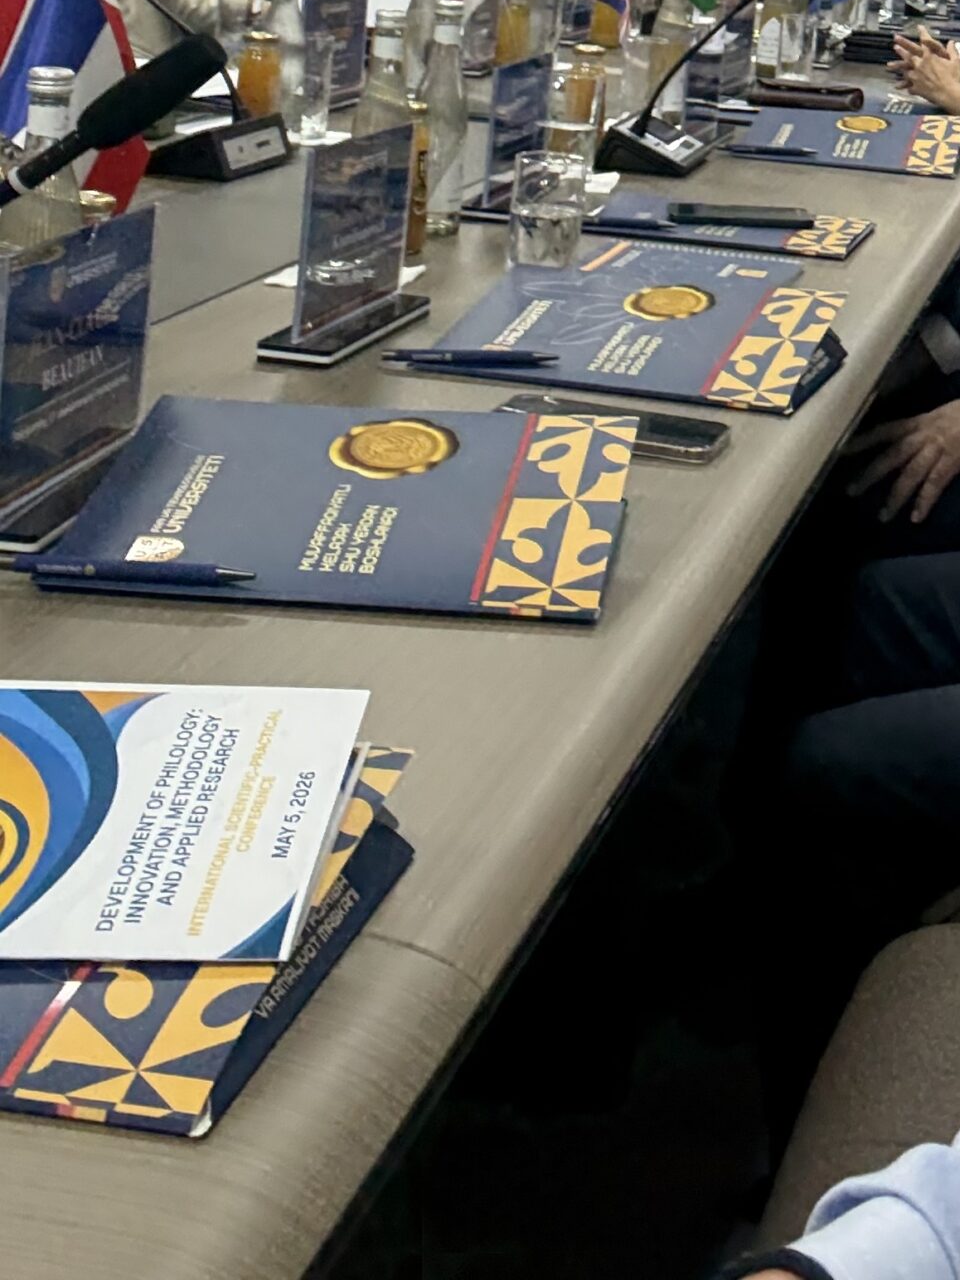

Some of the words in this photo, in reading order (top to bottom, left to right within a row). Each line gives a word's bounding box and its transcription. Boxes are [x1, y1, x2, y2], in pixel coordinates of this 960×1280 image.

[162, 455, 225, 533] UNIVERSITETI
[339, 547, 361, 573] SHU
[95, 813, 157, 932] DEVELOPMENT
[146, 791, 166, 810] OF
[156, 708, 203, 787] PHILOLOGY:
[124, 822, 180, 924] INNOVATION,
[165, 715, 222, 820] METHODOLOGY
[156, 870, 183, 906] AND
[172, 805, 209, 867] APPLIED
[199, 728, 240, 802] RESEARCH
[187, 836, 235, 936] INTERNATIONAL
[225, 708, 283, 832] SCIENTIFIC-PRACTICAL
[236, 775, 276, 853] CONFERENCE
[271, 825, 297, 859] MAY
